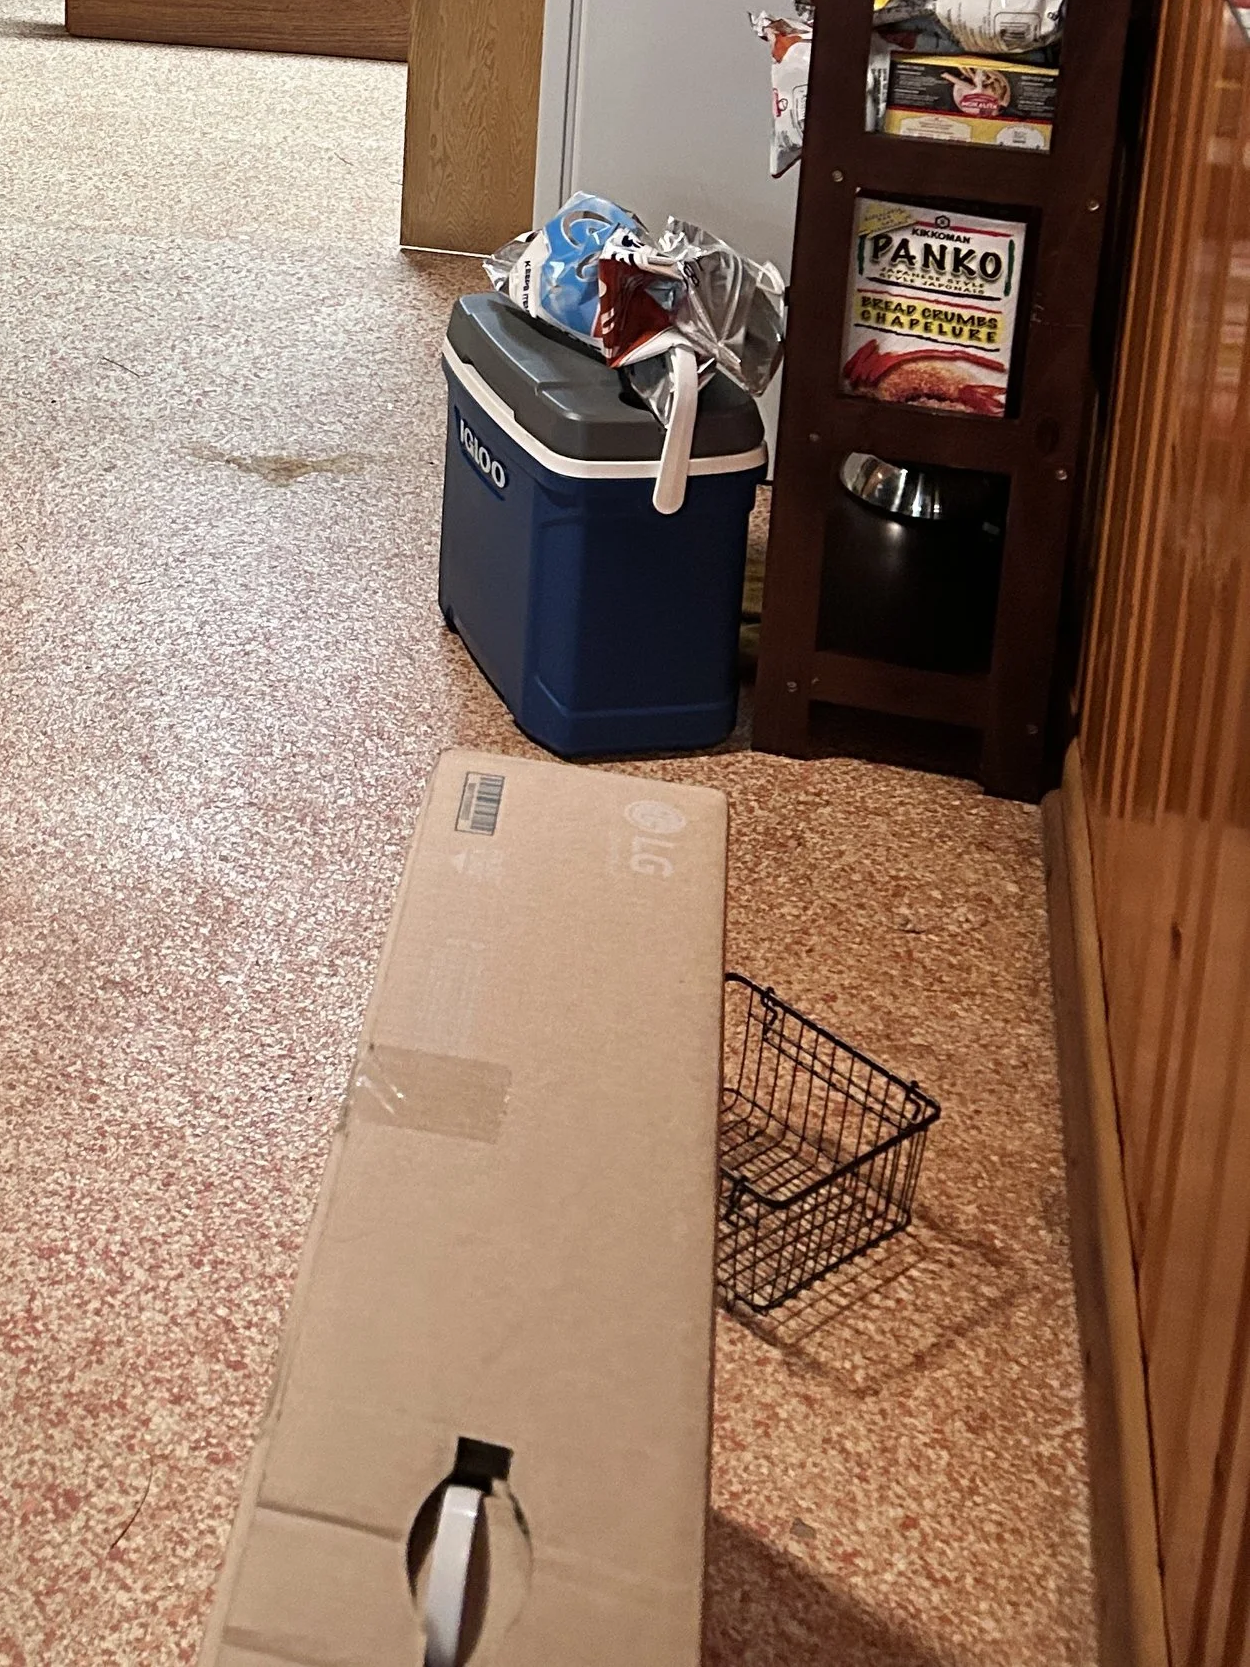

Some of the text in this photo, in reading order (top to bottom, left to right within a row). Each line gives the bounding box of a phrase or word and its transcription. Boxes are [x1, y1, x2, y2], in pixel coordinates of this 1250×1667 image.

[910, 228, 971, 245] KIKKOMAN
[871, 235, 1003, 279] PANKO
[879, 273, 915, 284] STYLE
[880, 267, 986, 289] JAPANESE STYLE
[860, 310, 998, 343] CHAPELURE
[861, 296, 998, 329] BREAD CRUMBS
[459, 419, 507, 489] IGLOO
[629, 835, 677, 879] LG
